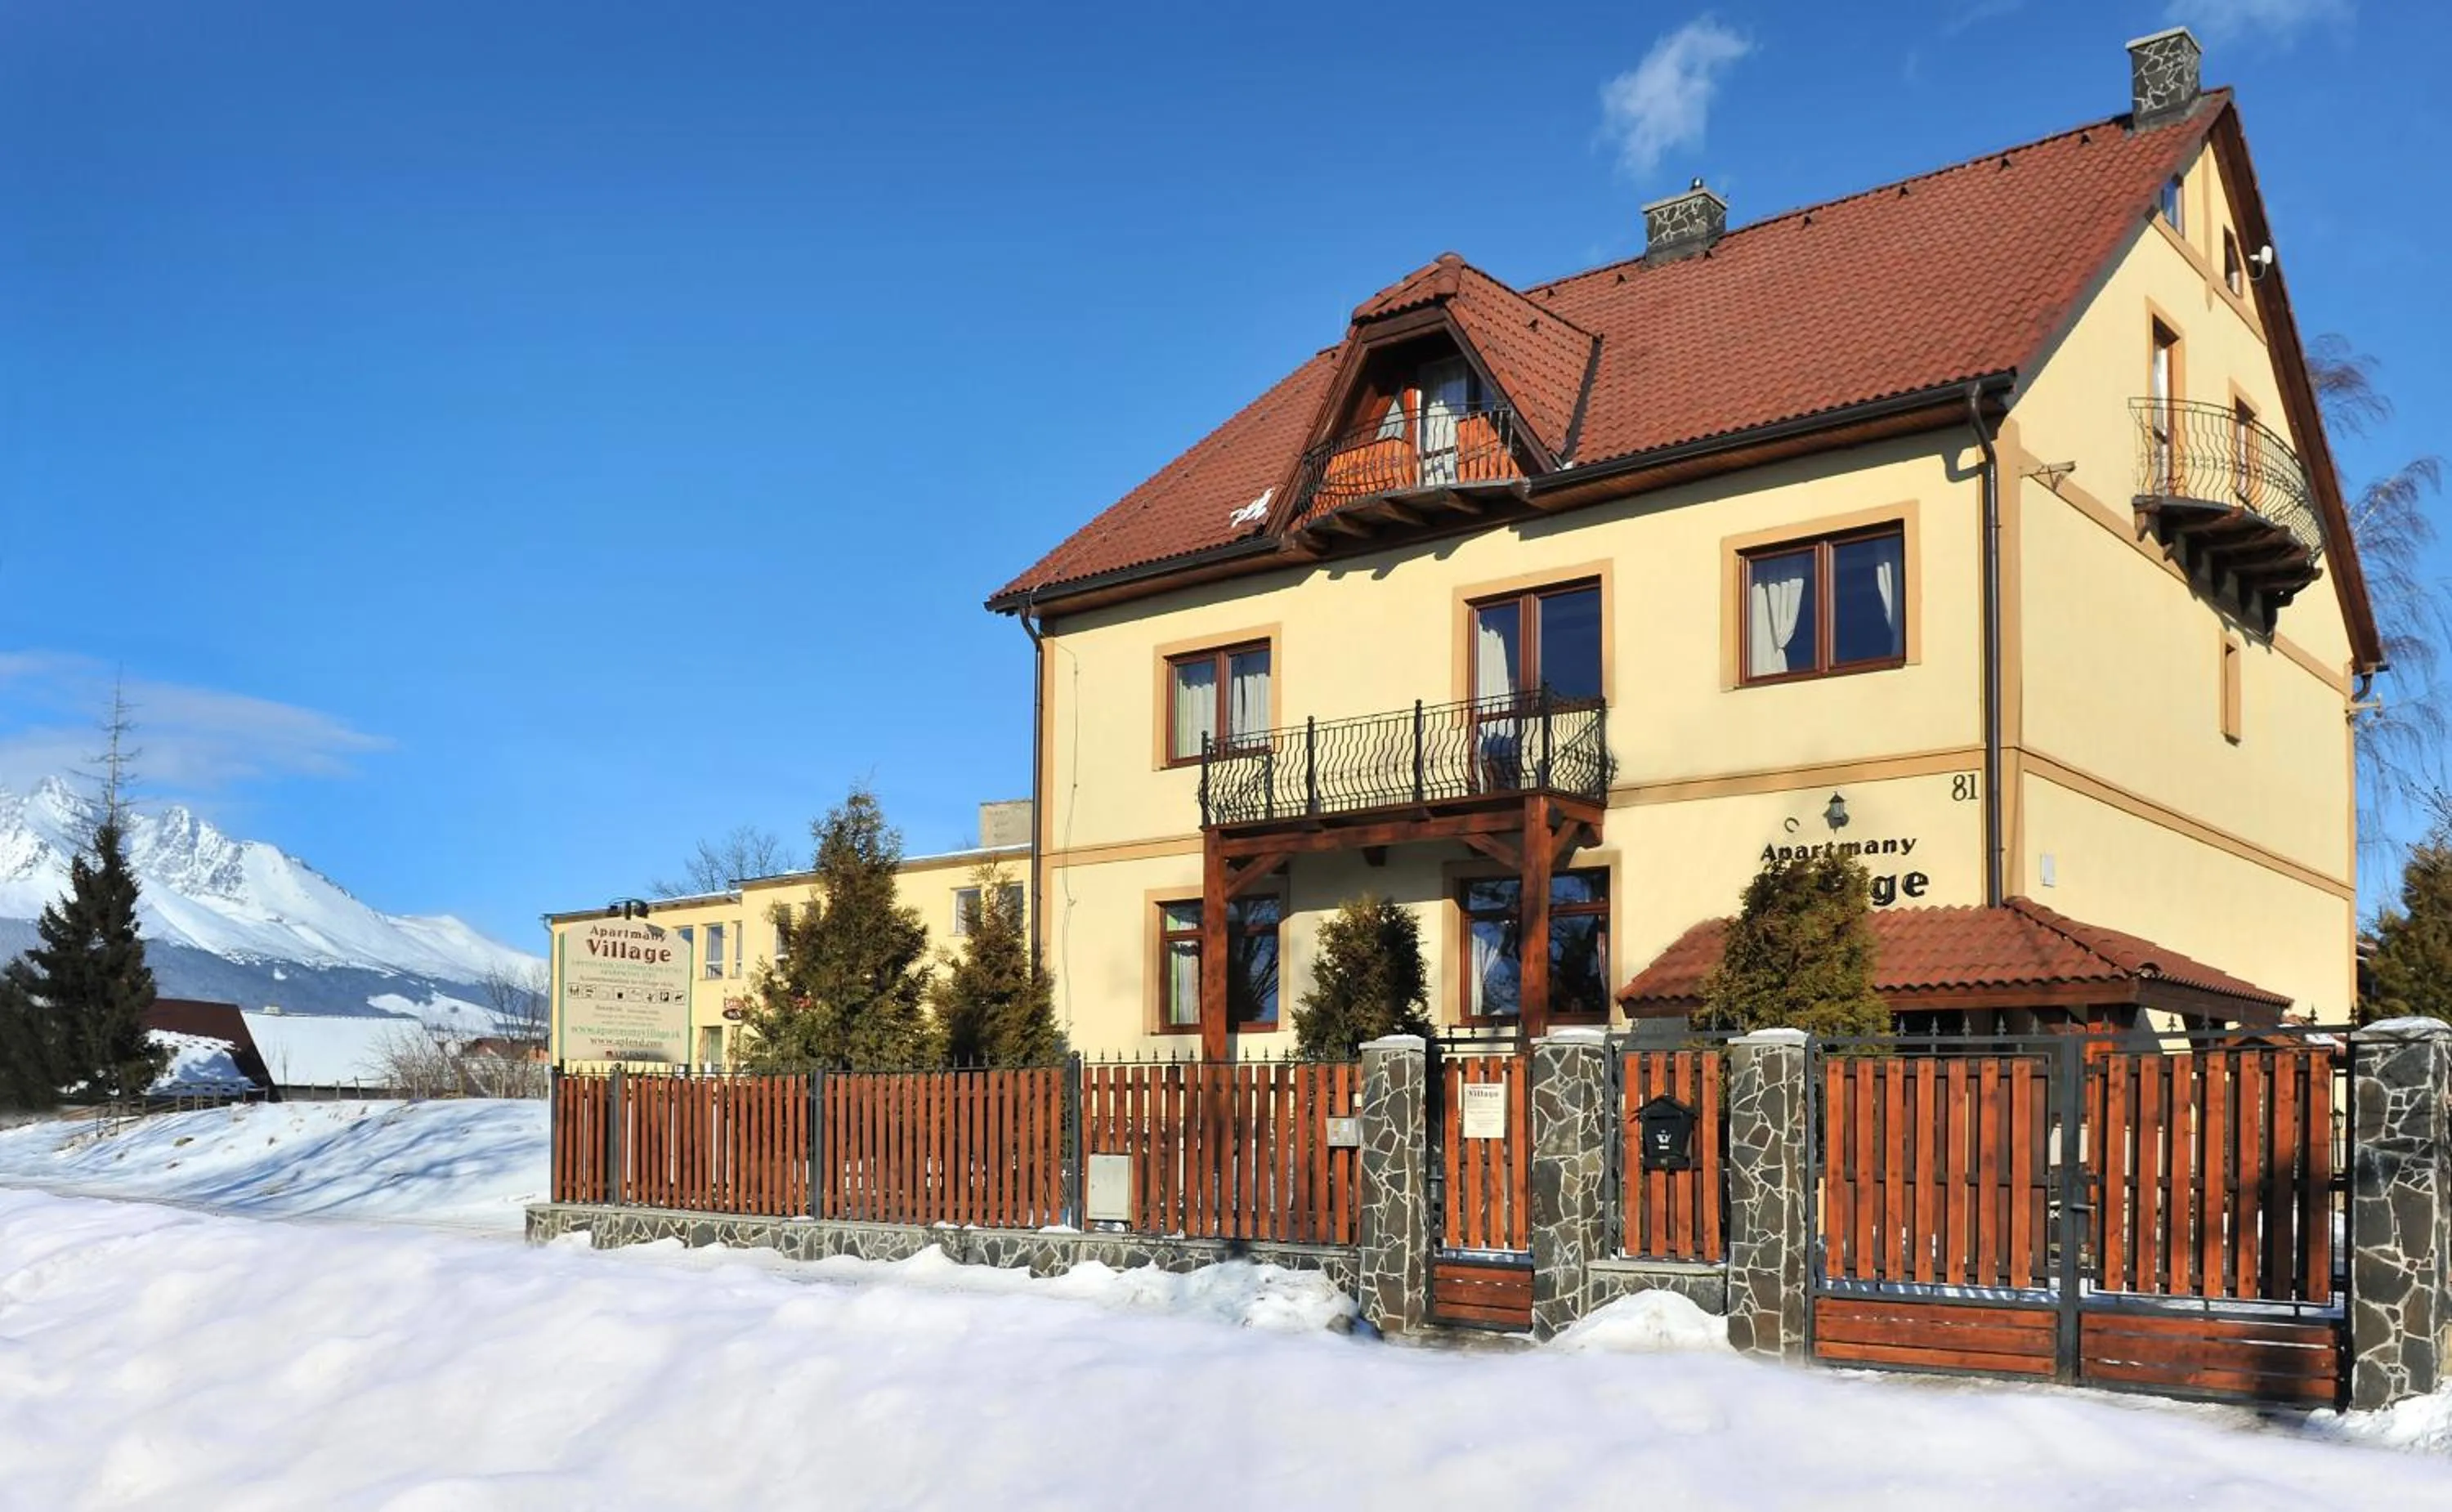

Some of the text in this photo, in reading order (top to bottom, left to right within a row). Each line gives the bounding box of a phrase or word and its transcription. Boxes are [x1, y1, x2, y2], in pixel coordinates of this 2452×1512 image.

[1952, 773, 1979, 801] 81
[589, 924, 666, 942] Apartmany
[586, 938, 672, 964] Village
